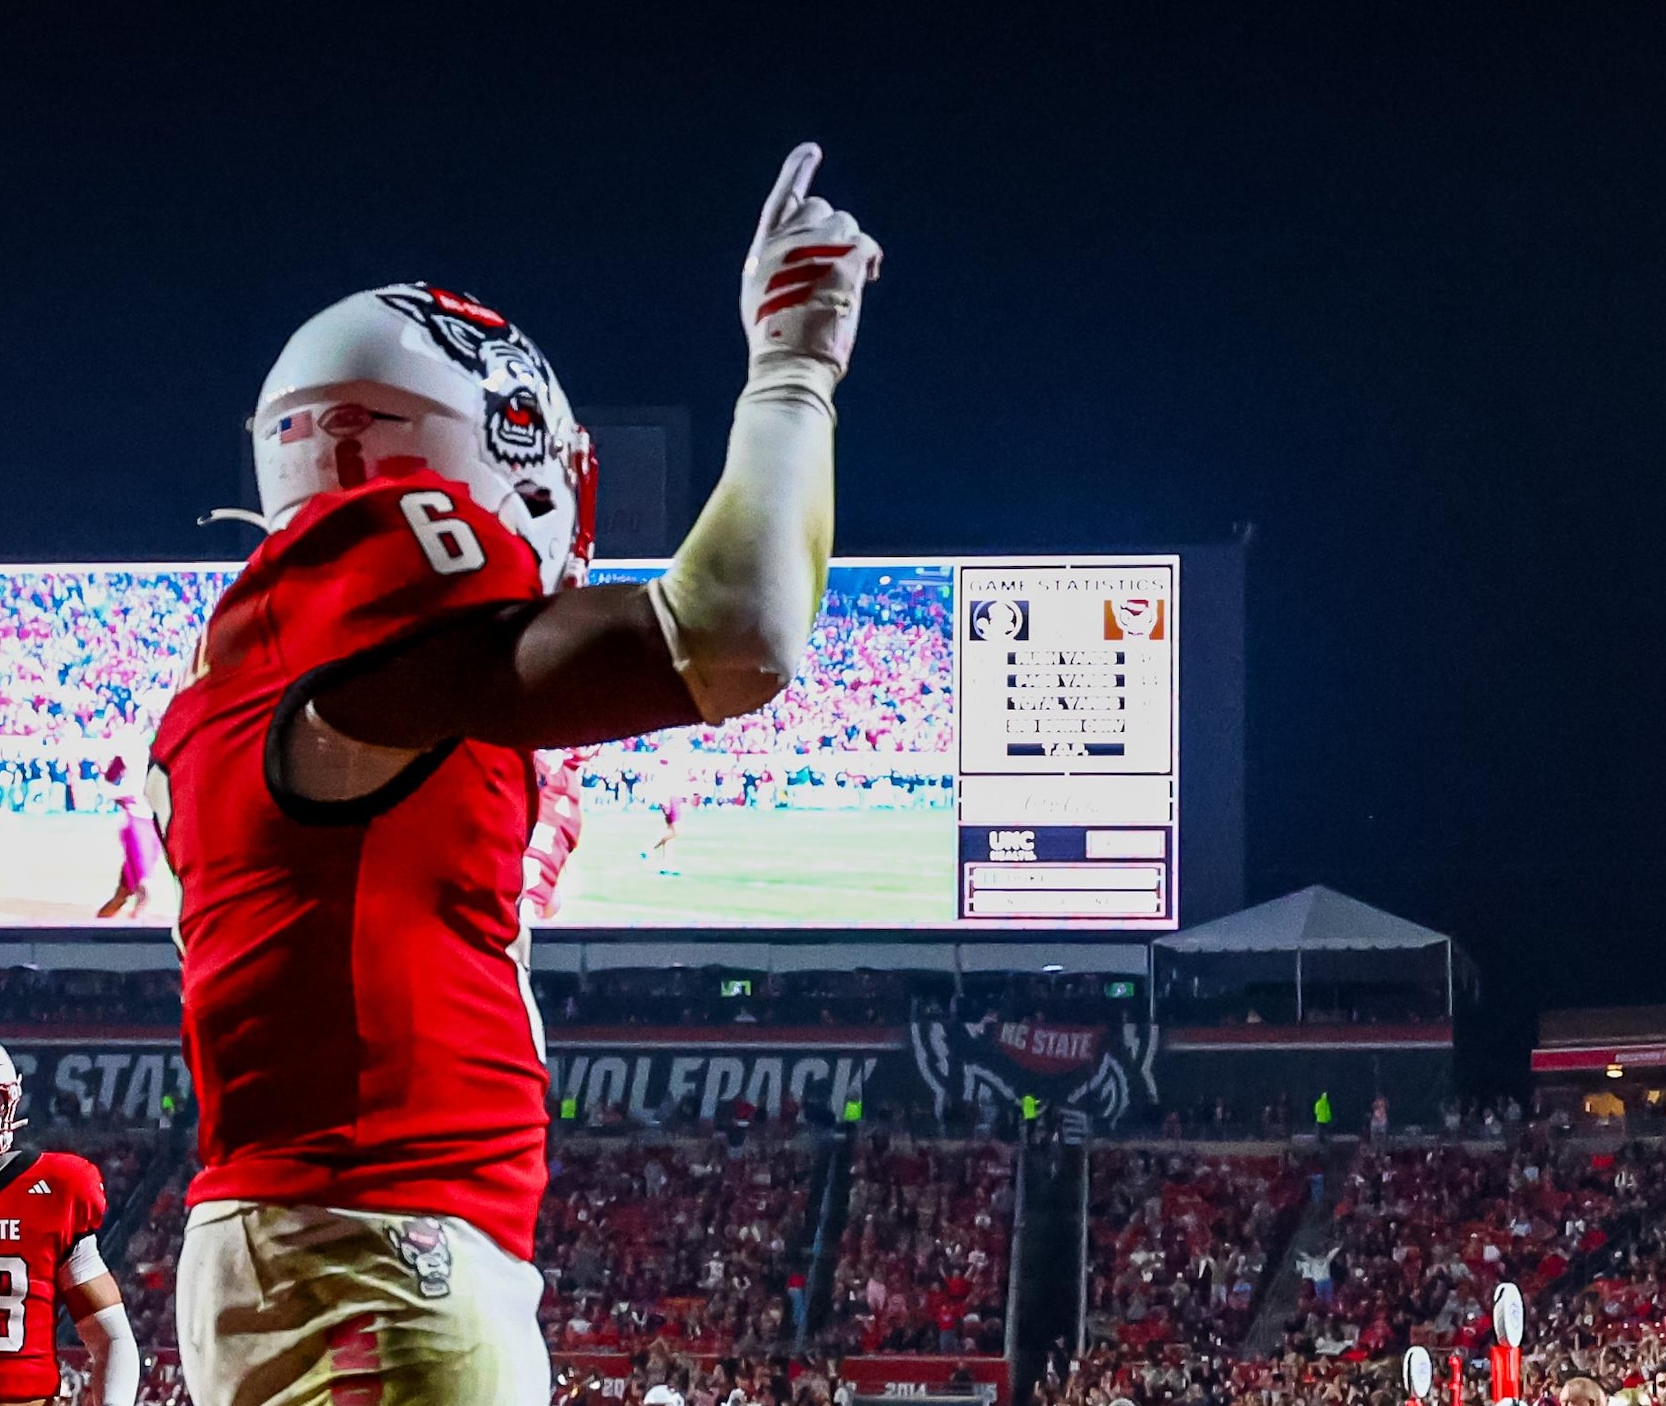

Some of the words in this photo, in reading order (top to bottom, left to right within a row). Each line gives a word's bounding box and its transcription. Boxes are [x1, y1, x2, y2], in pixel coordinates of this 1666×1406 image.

[399, 491, 486, 575] 6
[1000, 1021, 1027, 1050] NC
[1032, 1030, 1094, 1060] STATE
[49, 1053, 191, 1122] STAT
